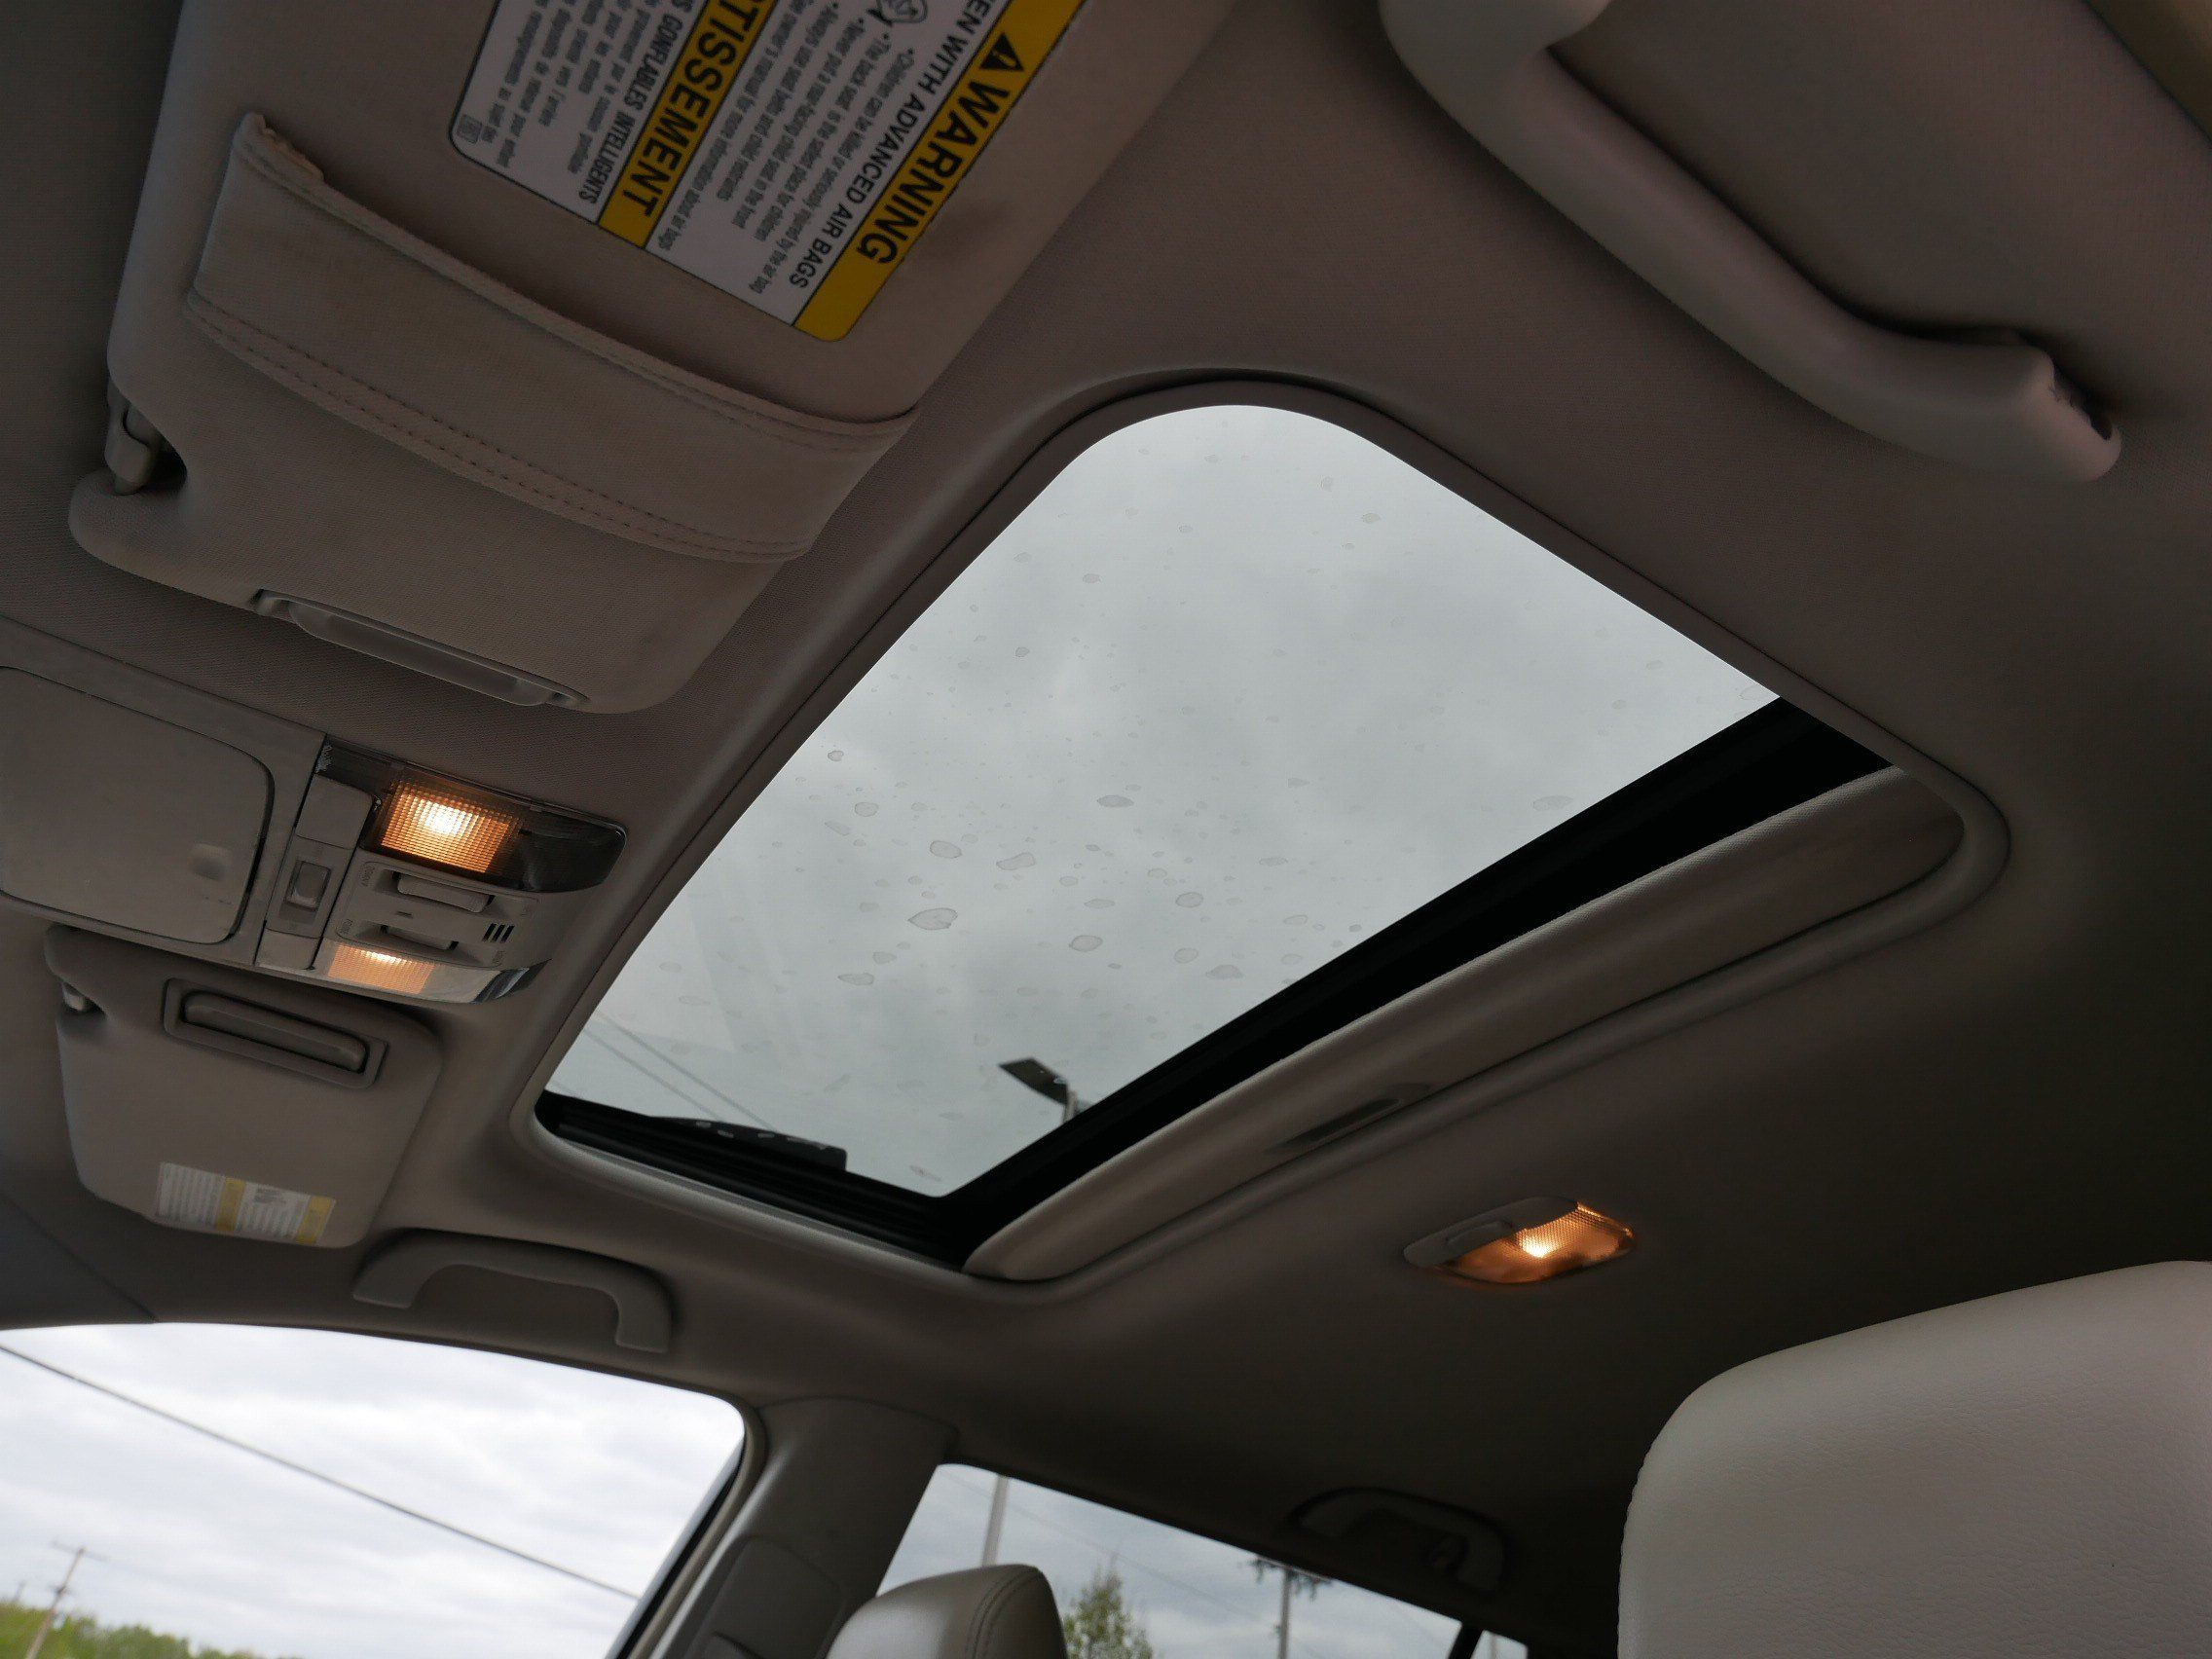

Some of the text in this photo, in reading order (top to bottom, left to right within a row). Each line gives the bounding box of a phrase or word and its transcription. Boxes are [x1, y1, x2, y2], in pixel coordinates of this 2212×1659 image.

[835, 21, 866, 56] Never
[865, 38, 892, 61] The
[624, 14, 682, 110] GONFLABLES
[822, 52, 842, 78] put
[849, 58, 875, 87] back
[624, 0, 758, 215] TISSEMENT
[834, 85, 858, 112] seat
[754, 113, 774, 138] and
[816, 121, 838, 140] the
[827, 109, 842, 124] is
[578, 111, 635, 203] INTELLIGENTS
[740, 133, 763, 162] child
[771, 134, 794, 163] child
[789, 0, 995, 288] EN WITH ADVANCED AIR BAGS
[748, 53, 914, 294] Children can be killed or seriously injured by the air bag
[759, 158, 781, 182] seat
[784, 165, 807, 194] place
[858, 83, 1008, 263] WARNING
[744, 188, 764, 206] the
[754, 178, 770, 192] in
[775, 191, 795, 208] for
[670, 214, 686, 231] air
[731, 203, 756, 230] front
[755, 205, 784, 241] children
